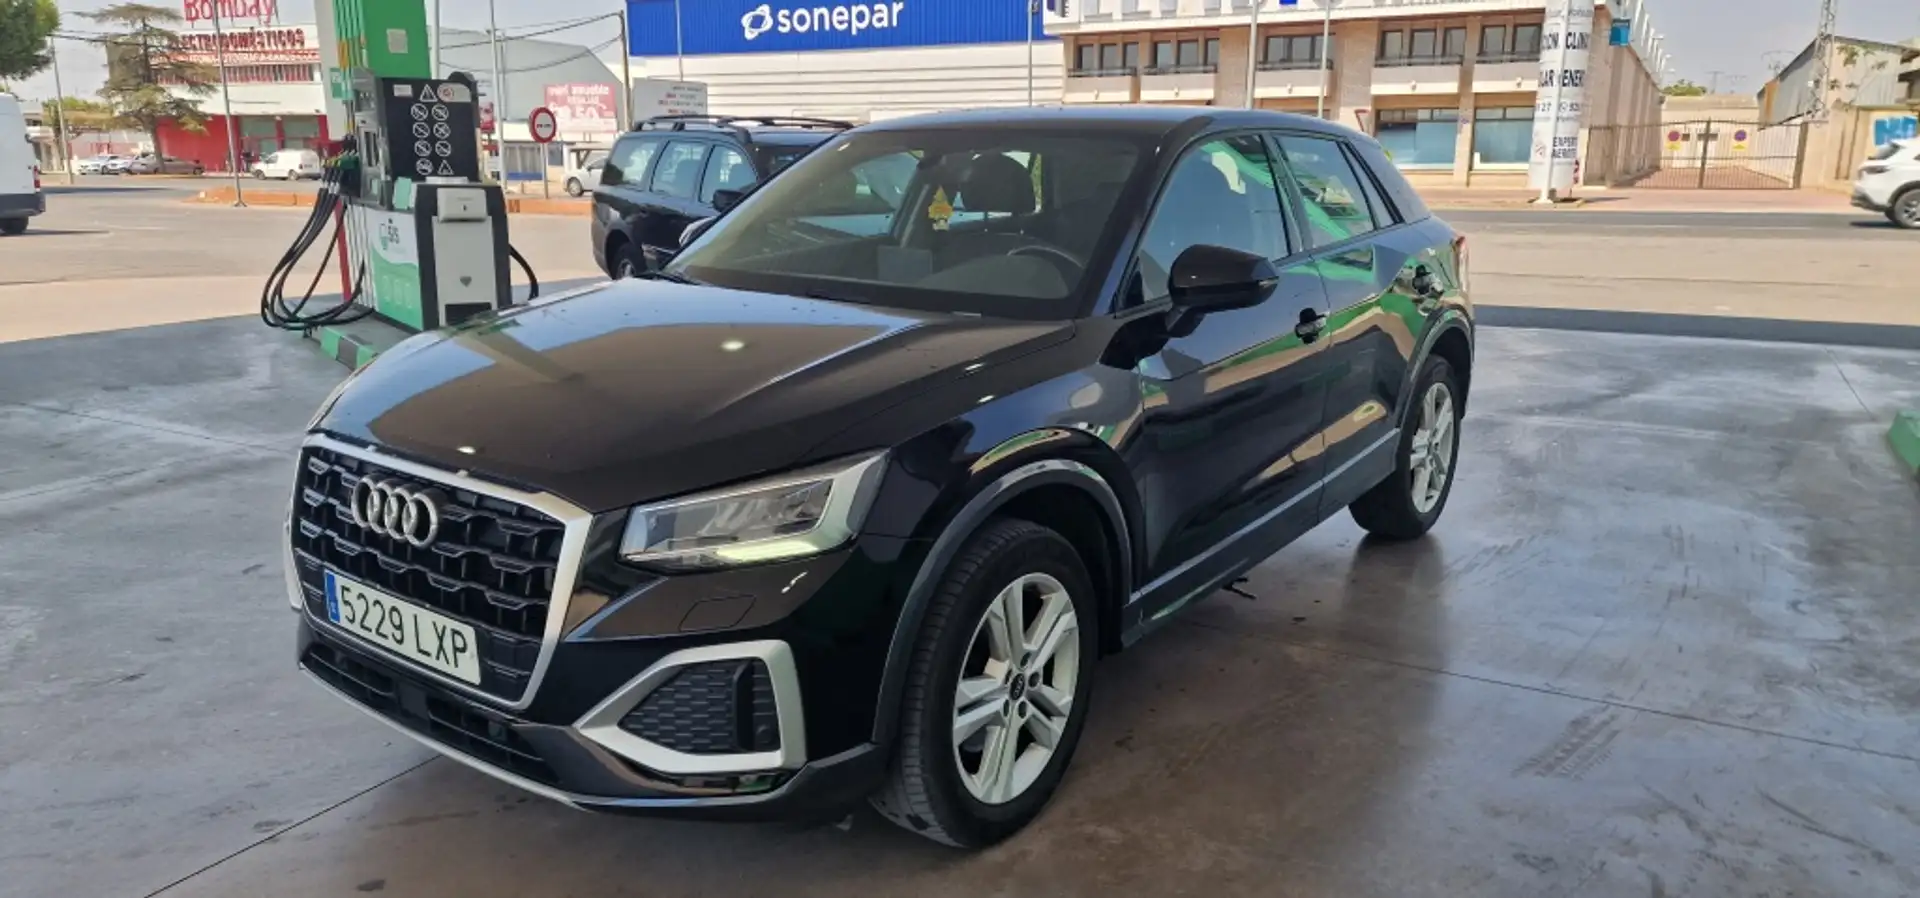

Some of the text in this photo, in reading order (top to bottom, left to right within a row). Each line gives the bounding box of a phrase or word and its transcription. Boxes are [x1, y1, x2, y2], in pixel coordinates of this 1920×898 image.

[777, 2, 904, 36] sonepar
[168, 27, 306, 51] ECTRODOMÉSTICOS
[340, 585, 467, 668] 5229 LXP
